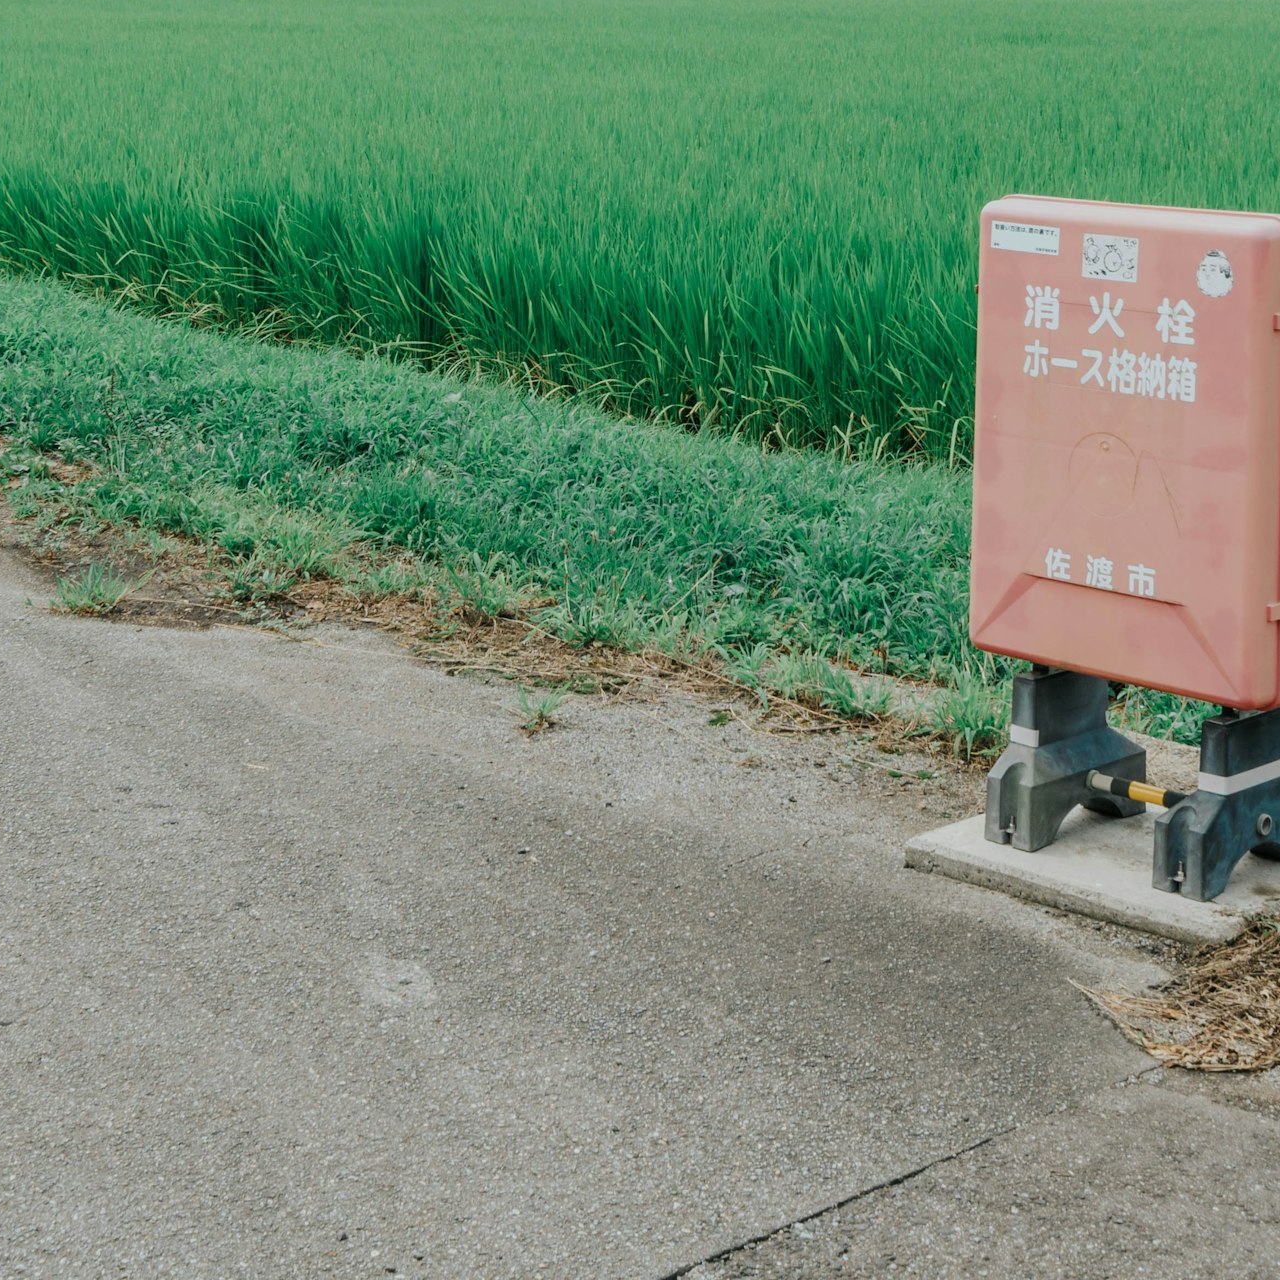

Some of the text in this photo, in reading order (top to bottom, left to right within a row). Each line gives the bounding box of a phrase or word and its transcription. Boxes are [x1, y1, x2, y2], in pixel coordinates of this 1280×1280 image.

[1023, 284, 1195, 345] 消火栓
[1023, 339, 1197, 402] ホース格納箱
[1045, 548, 1156, 596] 佐渡市
